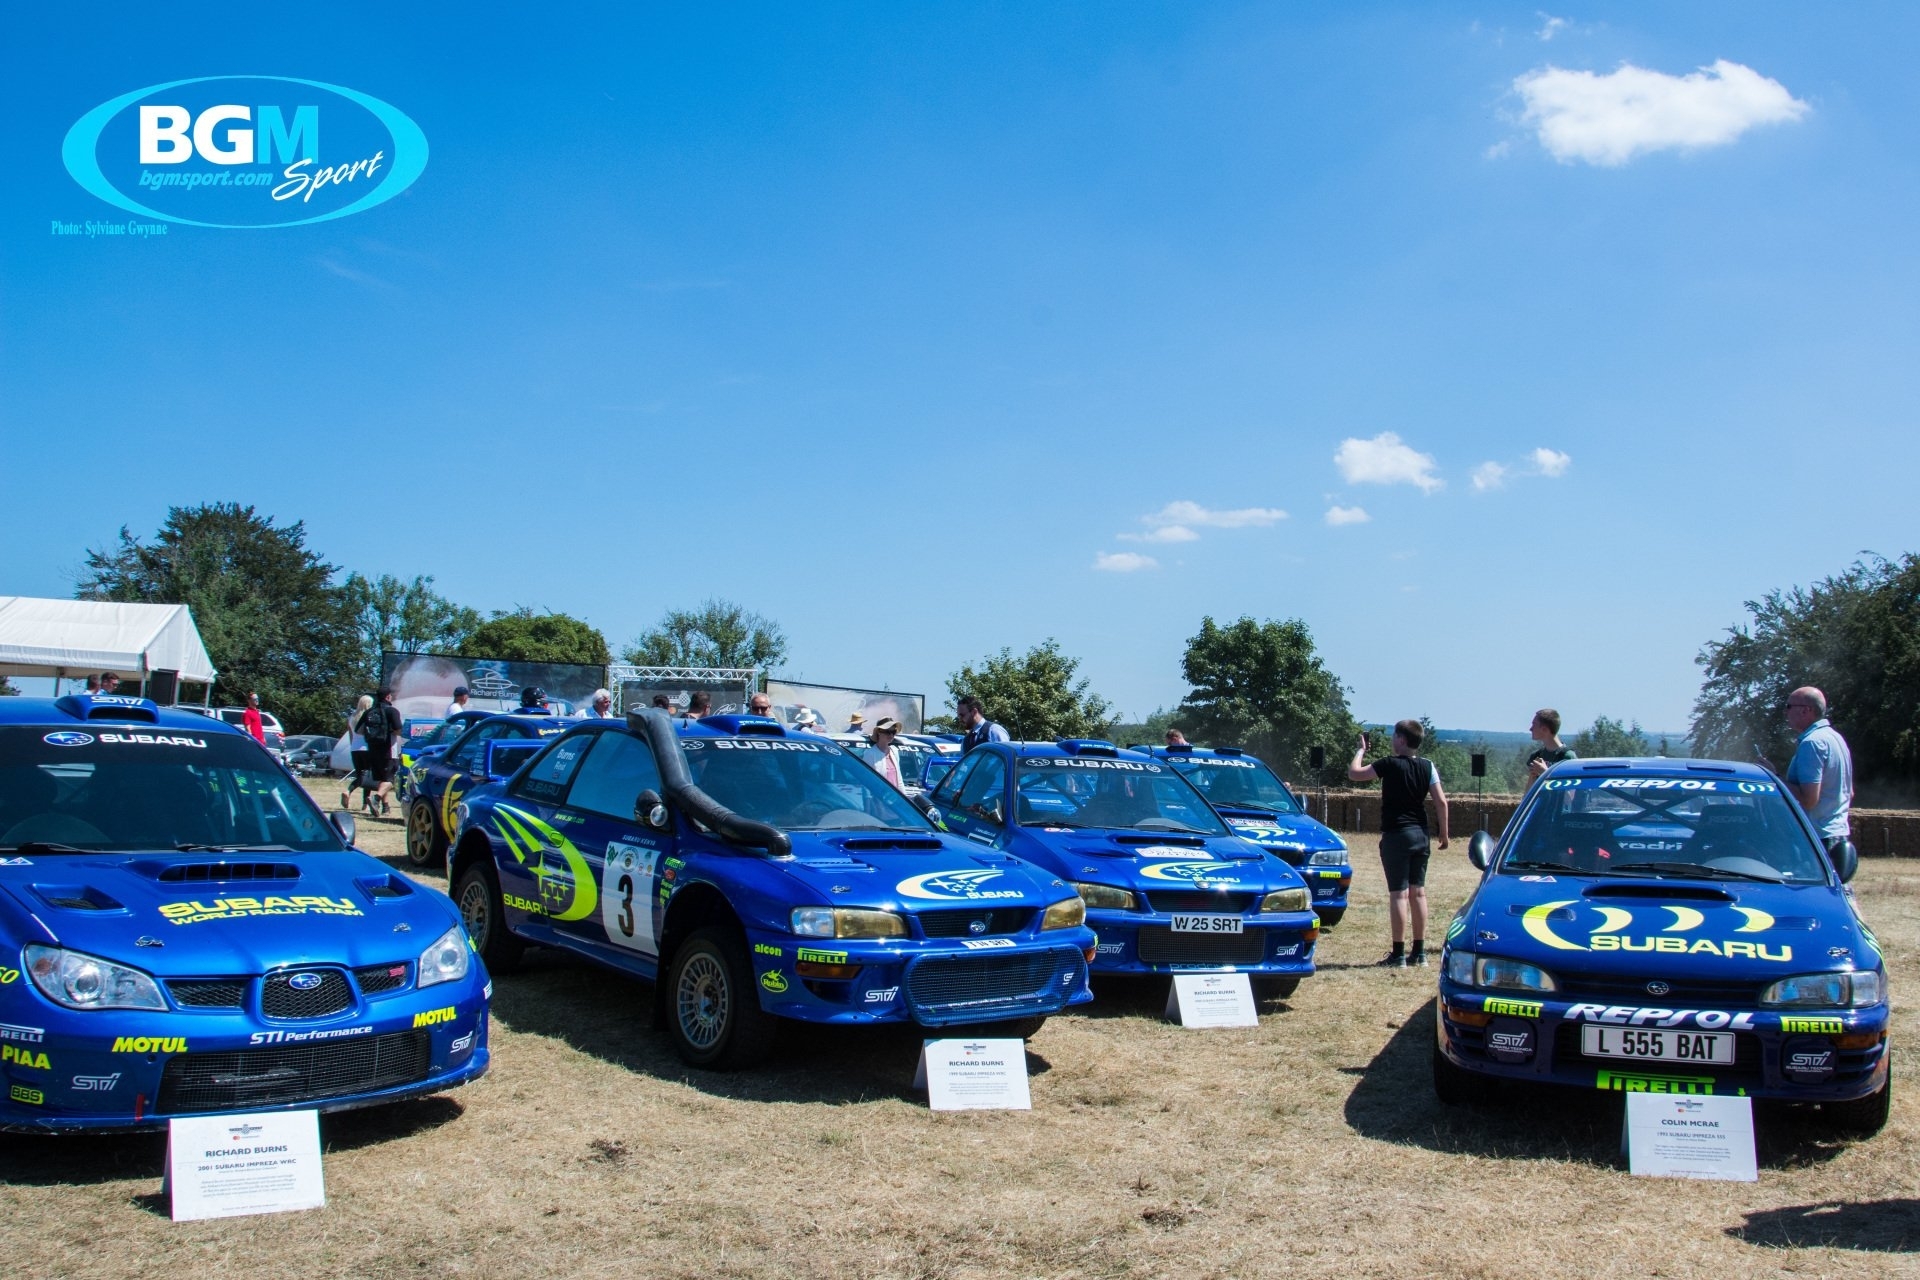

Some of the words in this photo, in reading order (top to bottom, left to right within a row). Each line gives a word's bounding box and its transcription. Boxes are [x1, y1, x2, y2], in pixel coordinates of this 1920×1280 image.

[100, 733, 207, 749] SUBARU
[715, 740, 820, 753] SUBARU
[1054, 759, 1143, 771] SUBARU
[1188, 758, 1255, 769] SUBARU
[526, 781, 560, 796] SUBARU
[1599, 779, 1717, 791] REPSOL
[966, 890, 1025, 899] SUBARU
[158, 896, 357, 919] SUBARU
[503, 893, 549, 916] SUBARU
[617, 874, 635, 938] 3
[169, 910, 245, 926] WORLD
[249, 907, 311, 918] RALLY
[310, 907, 365, 917] TEAM
[1174, 916, 1189, 930] W
[1191, 917, 1209, 931] 25
[1212, 917, 1242, 932] SRT
[754, 944, 782, 957] alcon
[797, 947, 849, 964] PIRELLI
[1590, 935, 1794, 962] SUBARU
[1484, 997, 1544, 1018] PIRELLI
[413, 1006, 456, 1028] MOTUL
[1563, 1003, 1756, 1030] REPSOL
[1780, 1016, 1843, 1033] PIRELLI
[0, 1023, 45, 1042] RELLI
[250, 1030, 284, 1045] STI
[286, 1025, 373, 1042] Performance
[112, 1037, 188, 1053] MOTUL
[1598, 1029, 1610, 1053] L
[1623, 1031, 1664, 1057] 555
[1677, 1034, 1718, 1060] BAT
[2, 1044, 51, 1069] PIAA
[1597, 1070, 1716, 1096] PIRELLI
[12, 1085, 42, 1102] BBS
[1689, 1120, 1720, 1128] MCRAE
[205, 1147, 252, 1158] RICHARD
[254, 1144, 288, 1154] BURNS
[215, 1162, 245, 1170] SUBARU
[246, 1159, 278, 1168] IMPREZA
